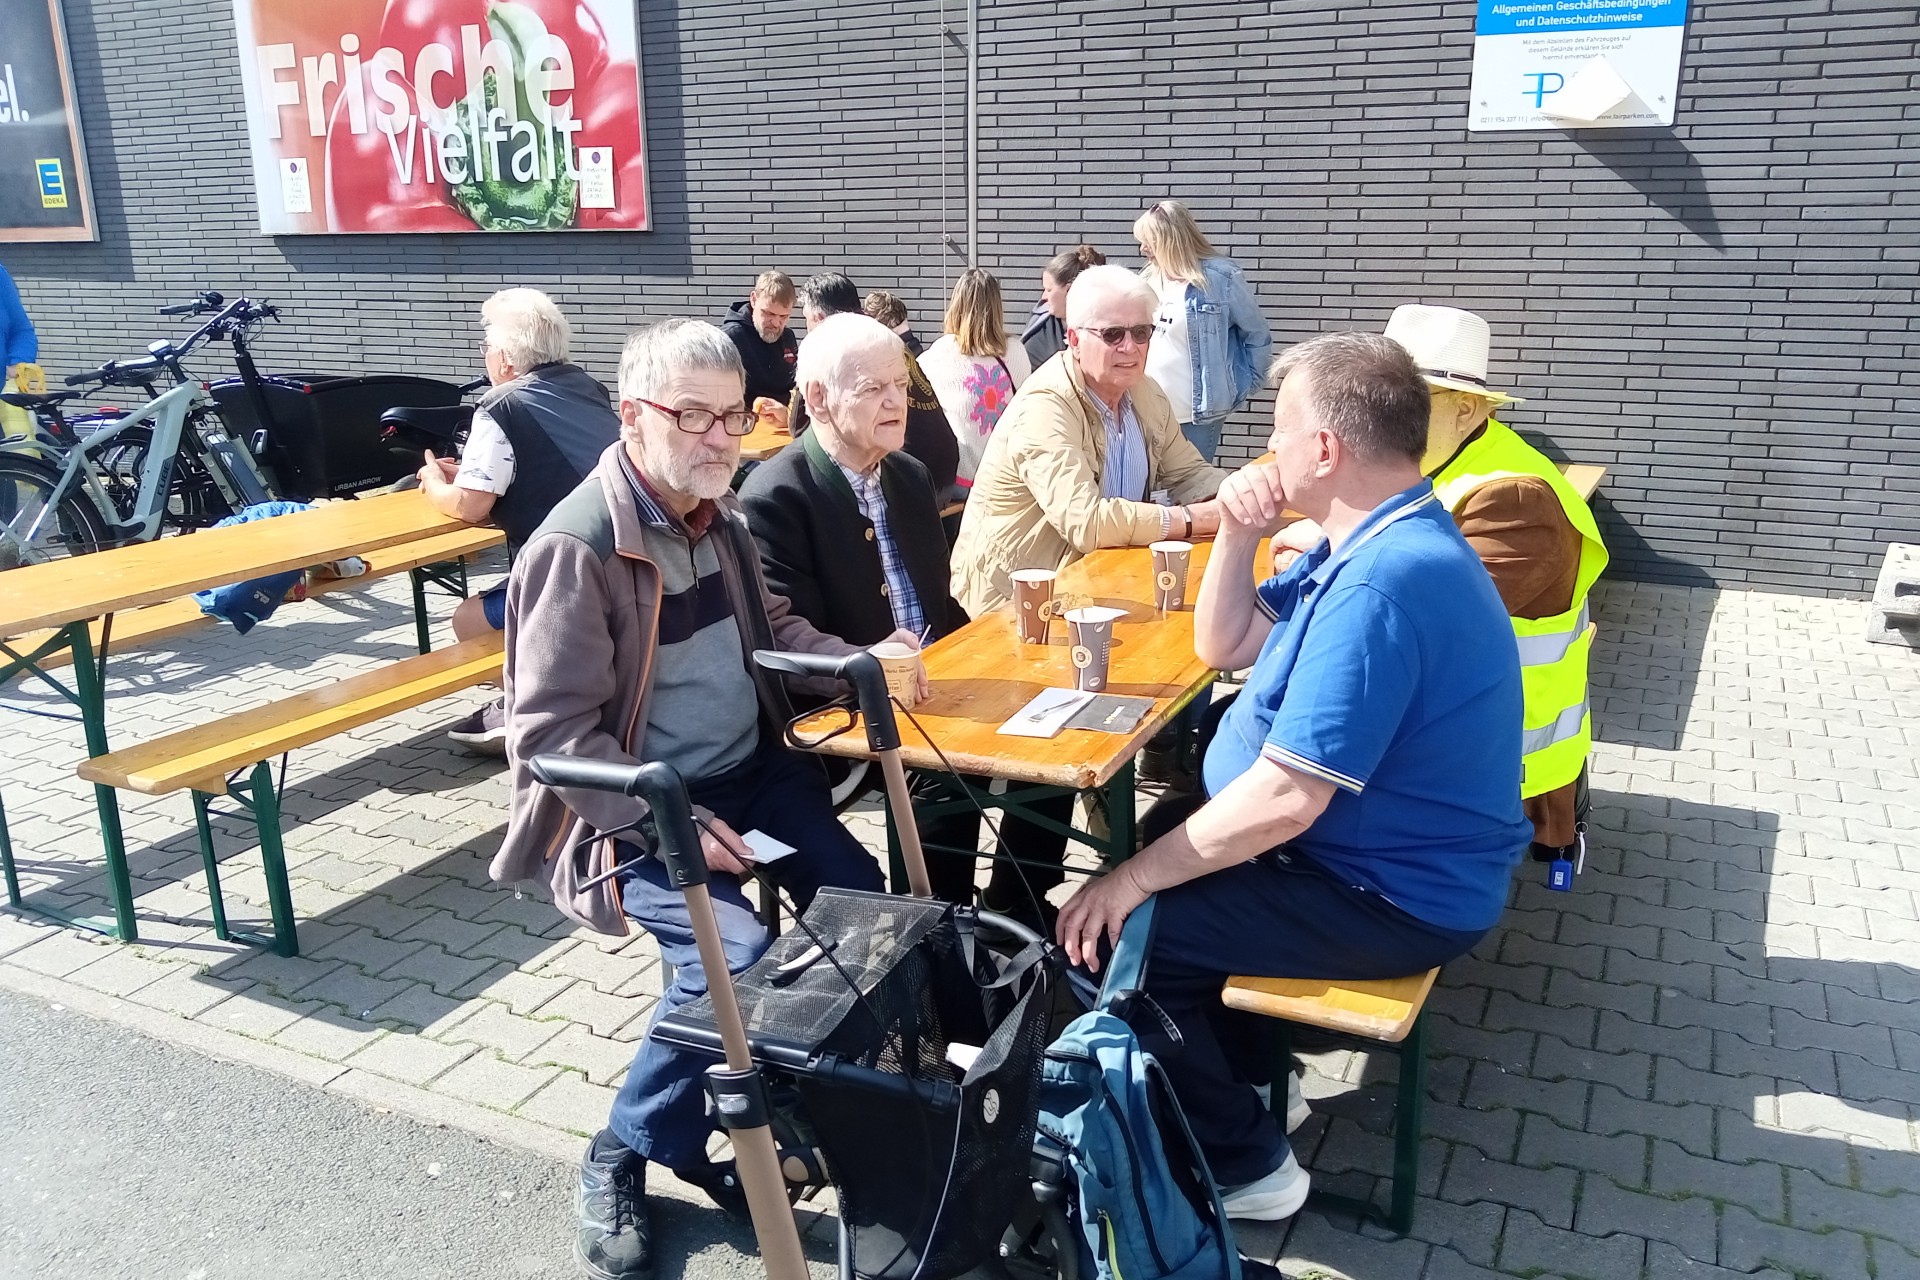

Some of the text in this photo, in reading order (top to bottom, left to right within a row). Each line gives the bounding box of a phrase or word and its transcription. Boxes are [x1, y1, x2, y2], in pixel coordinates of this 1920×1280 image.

[1491, 0, 1671, 16] Allgemeinen Geschäftsbedingungen
[1515, 12, 1644, 27] und Datenschutzhinweise
[256, 24, 575, 139] Frische
[383, 103, 582, 185] Vielfalt
[906, 396, 940, 411] Taunus
[157, 460, 171, 497] CUBE
[334, 476, 382, 492] URBAN ARROW
